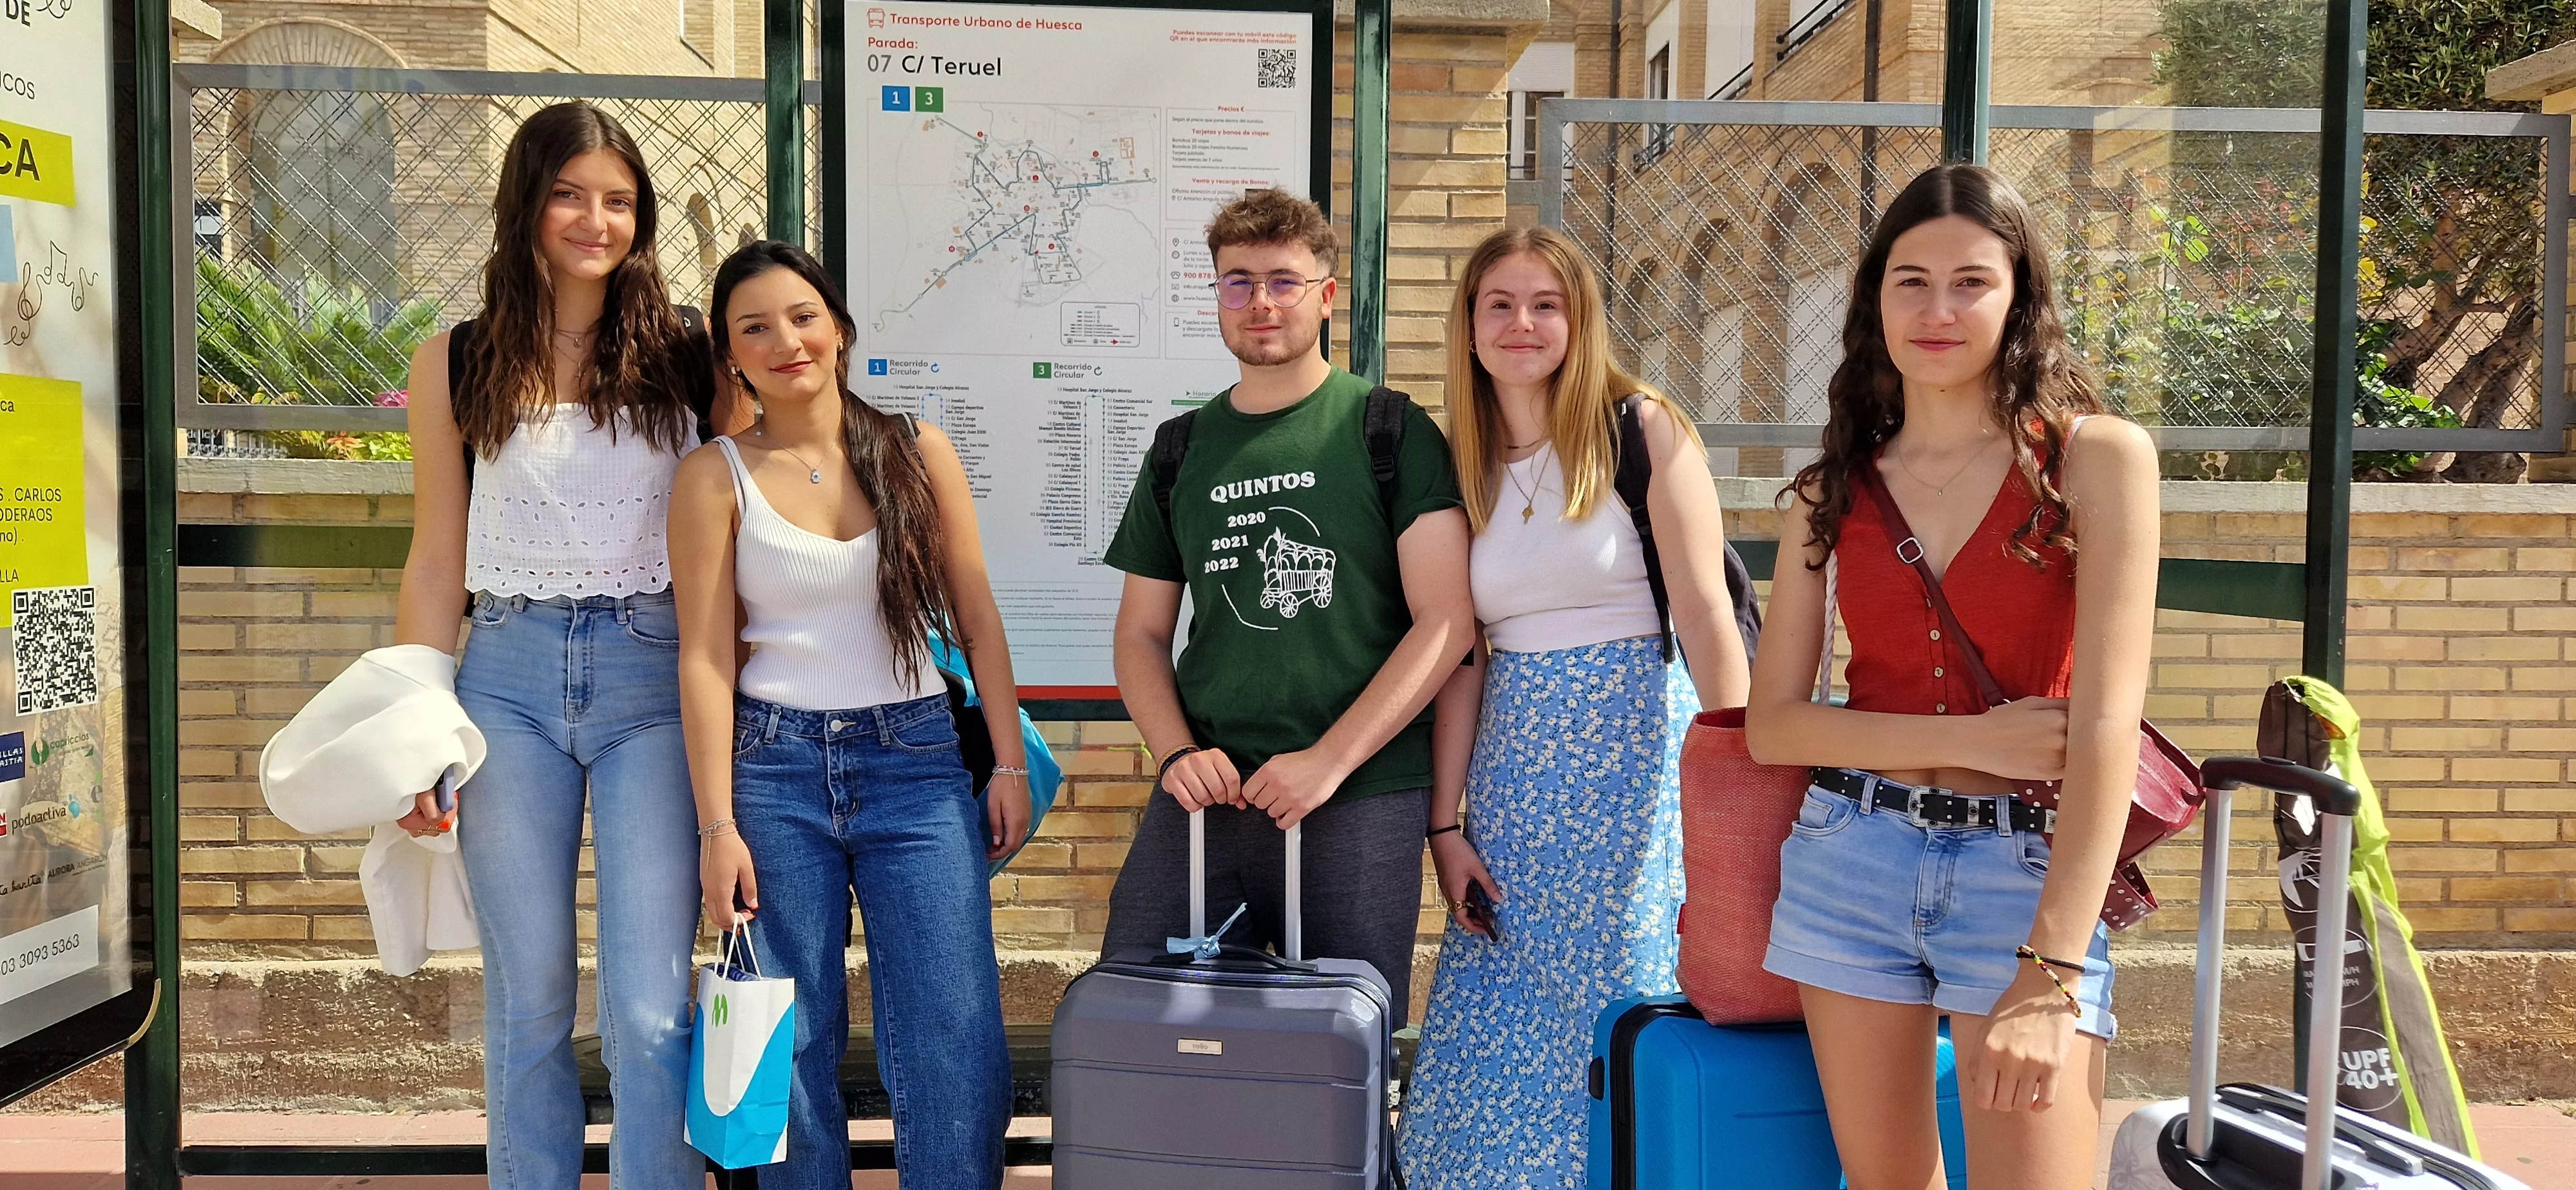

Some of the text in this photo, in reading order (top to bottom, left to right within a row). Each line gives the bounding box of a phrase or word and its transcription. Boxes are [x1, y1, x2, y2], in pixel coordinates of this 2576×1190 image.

[6, 0, 30, 27] DE
[891, 14, 1083, 30] Transporte Urbano de Huesca
[868, 37, 918, 50] Parada:
[867, 54, 1001, 75] 07 C/ Teruel
[892, 91, 933, 106] 1 3
[875, 362, 881, 372] 1
[1038, 366, 1045, 375] 3
[15, 487, 61, 502] CARLOS
[1210, 471, 1316, 504] QUINTOS
[1227, 511, 1266, 528] 2020
[1211, 534, 1249, 551] 2021
[1204, 556, 1239, 574] 2022
[12, 806, 67, 835] podoactiva
[0, 934, 80, 976] 03 3093 5363
[2341, 1047, 2391, 1071] UPF
[2346, 1068, 2399, 1090] 40+
